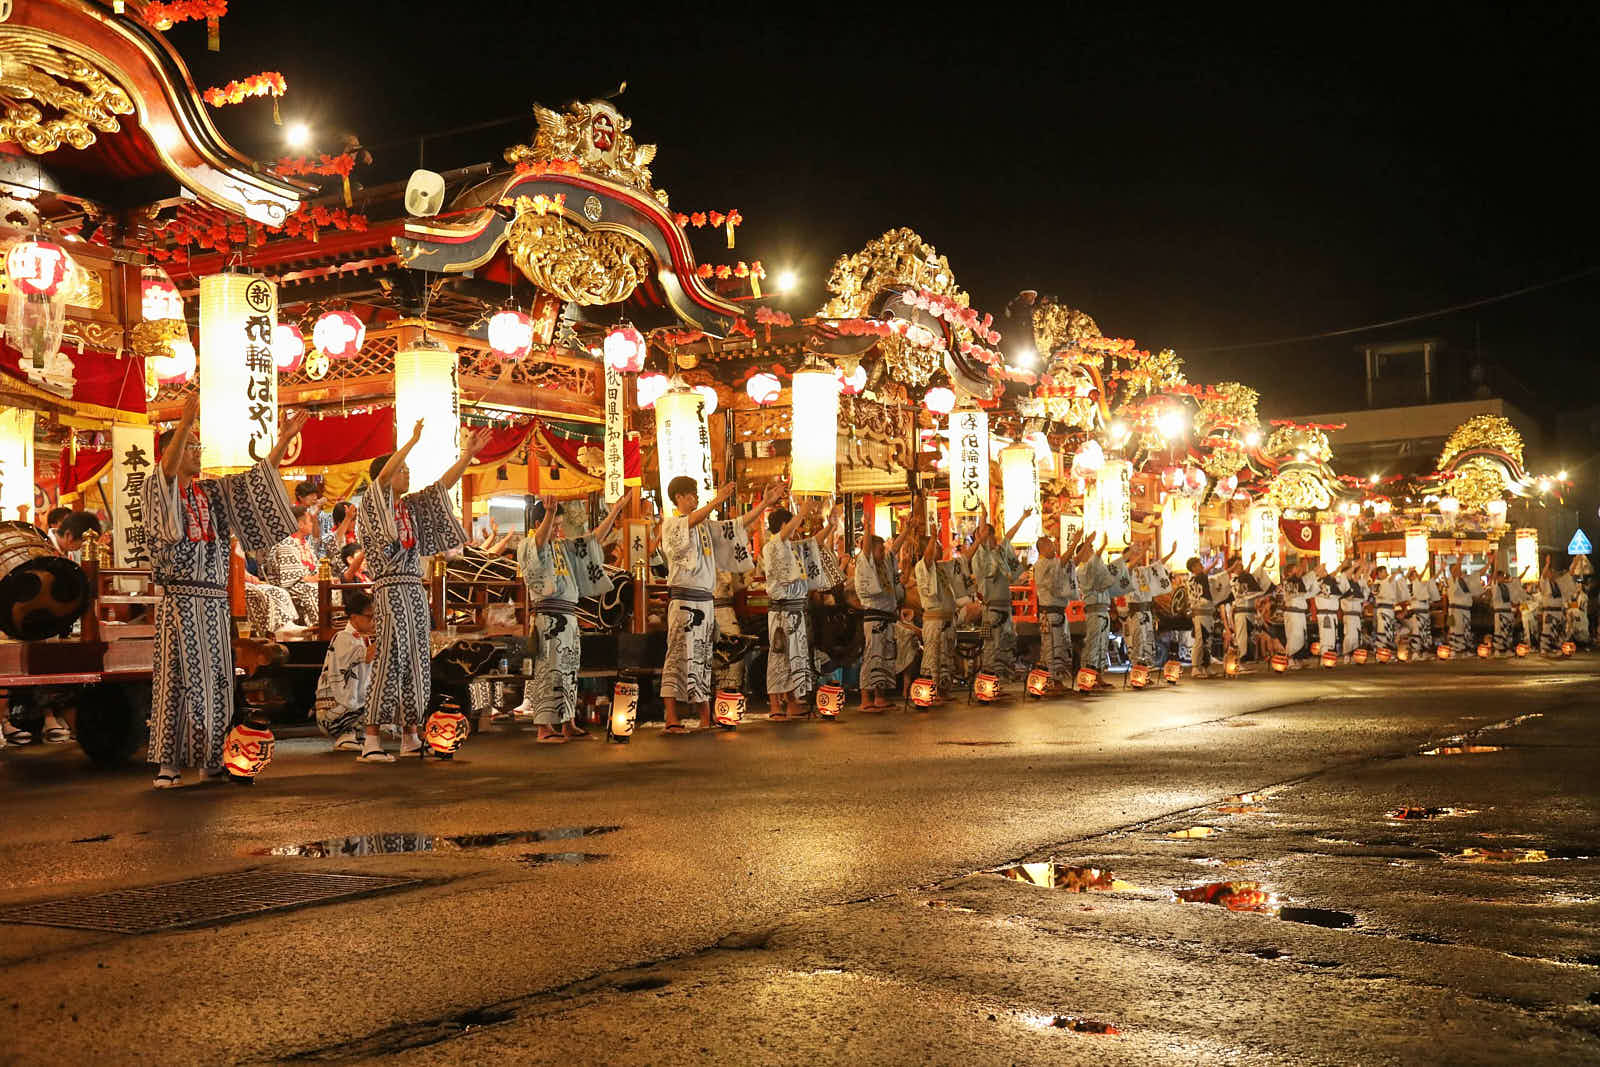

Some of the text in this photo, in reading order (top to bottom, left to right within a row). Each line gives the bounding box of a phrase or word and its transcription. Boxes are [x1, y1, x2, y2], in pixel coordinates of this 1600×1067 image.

[606, 366, 621, 497] 秋田県知事賞
[122, 444, 150, 569] 本屋台囃子
